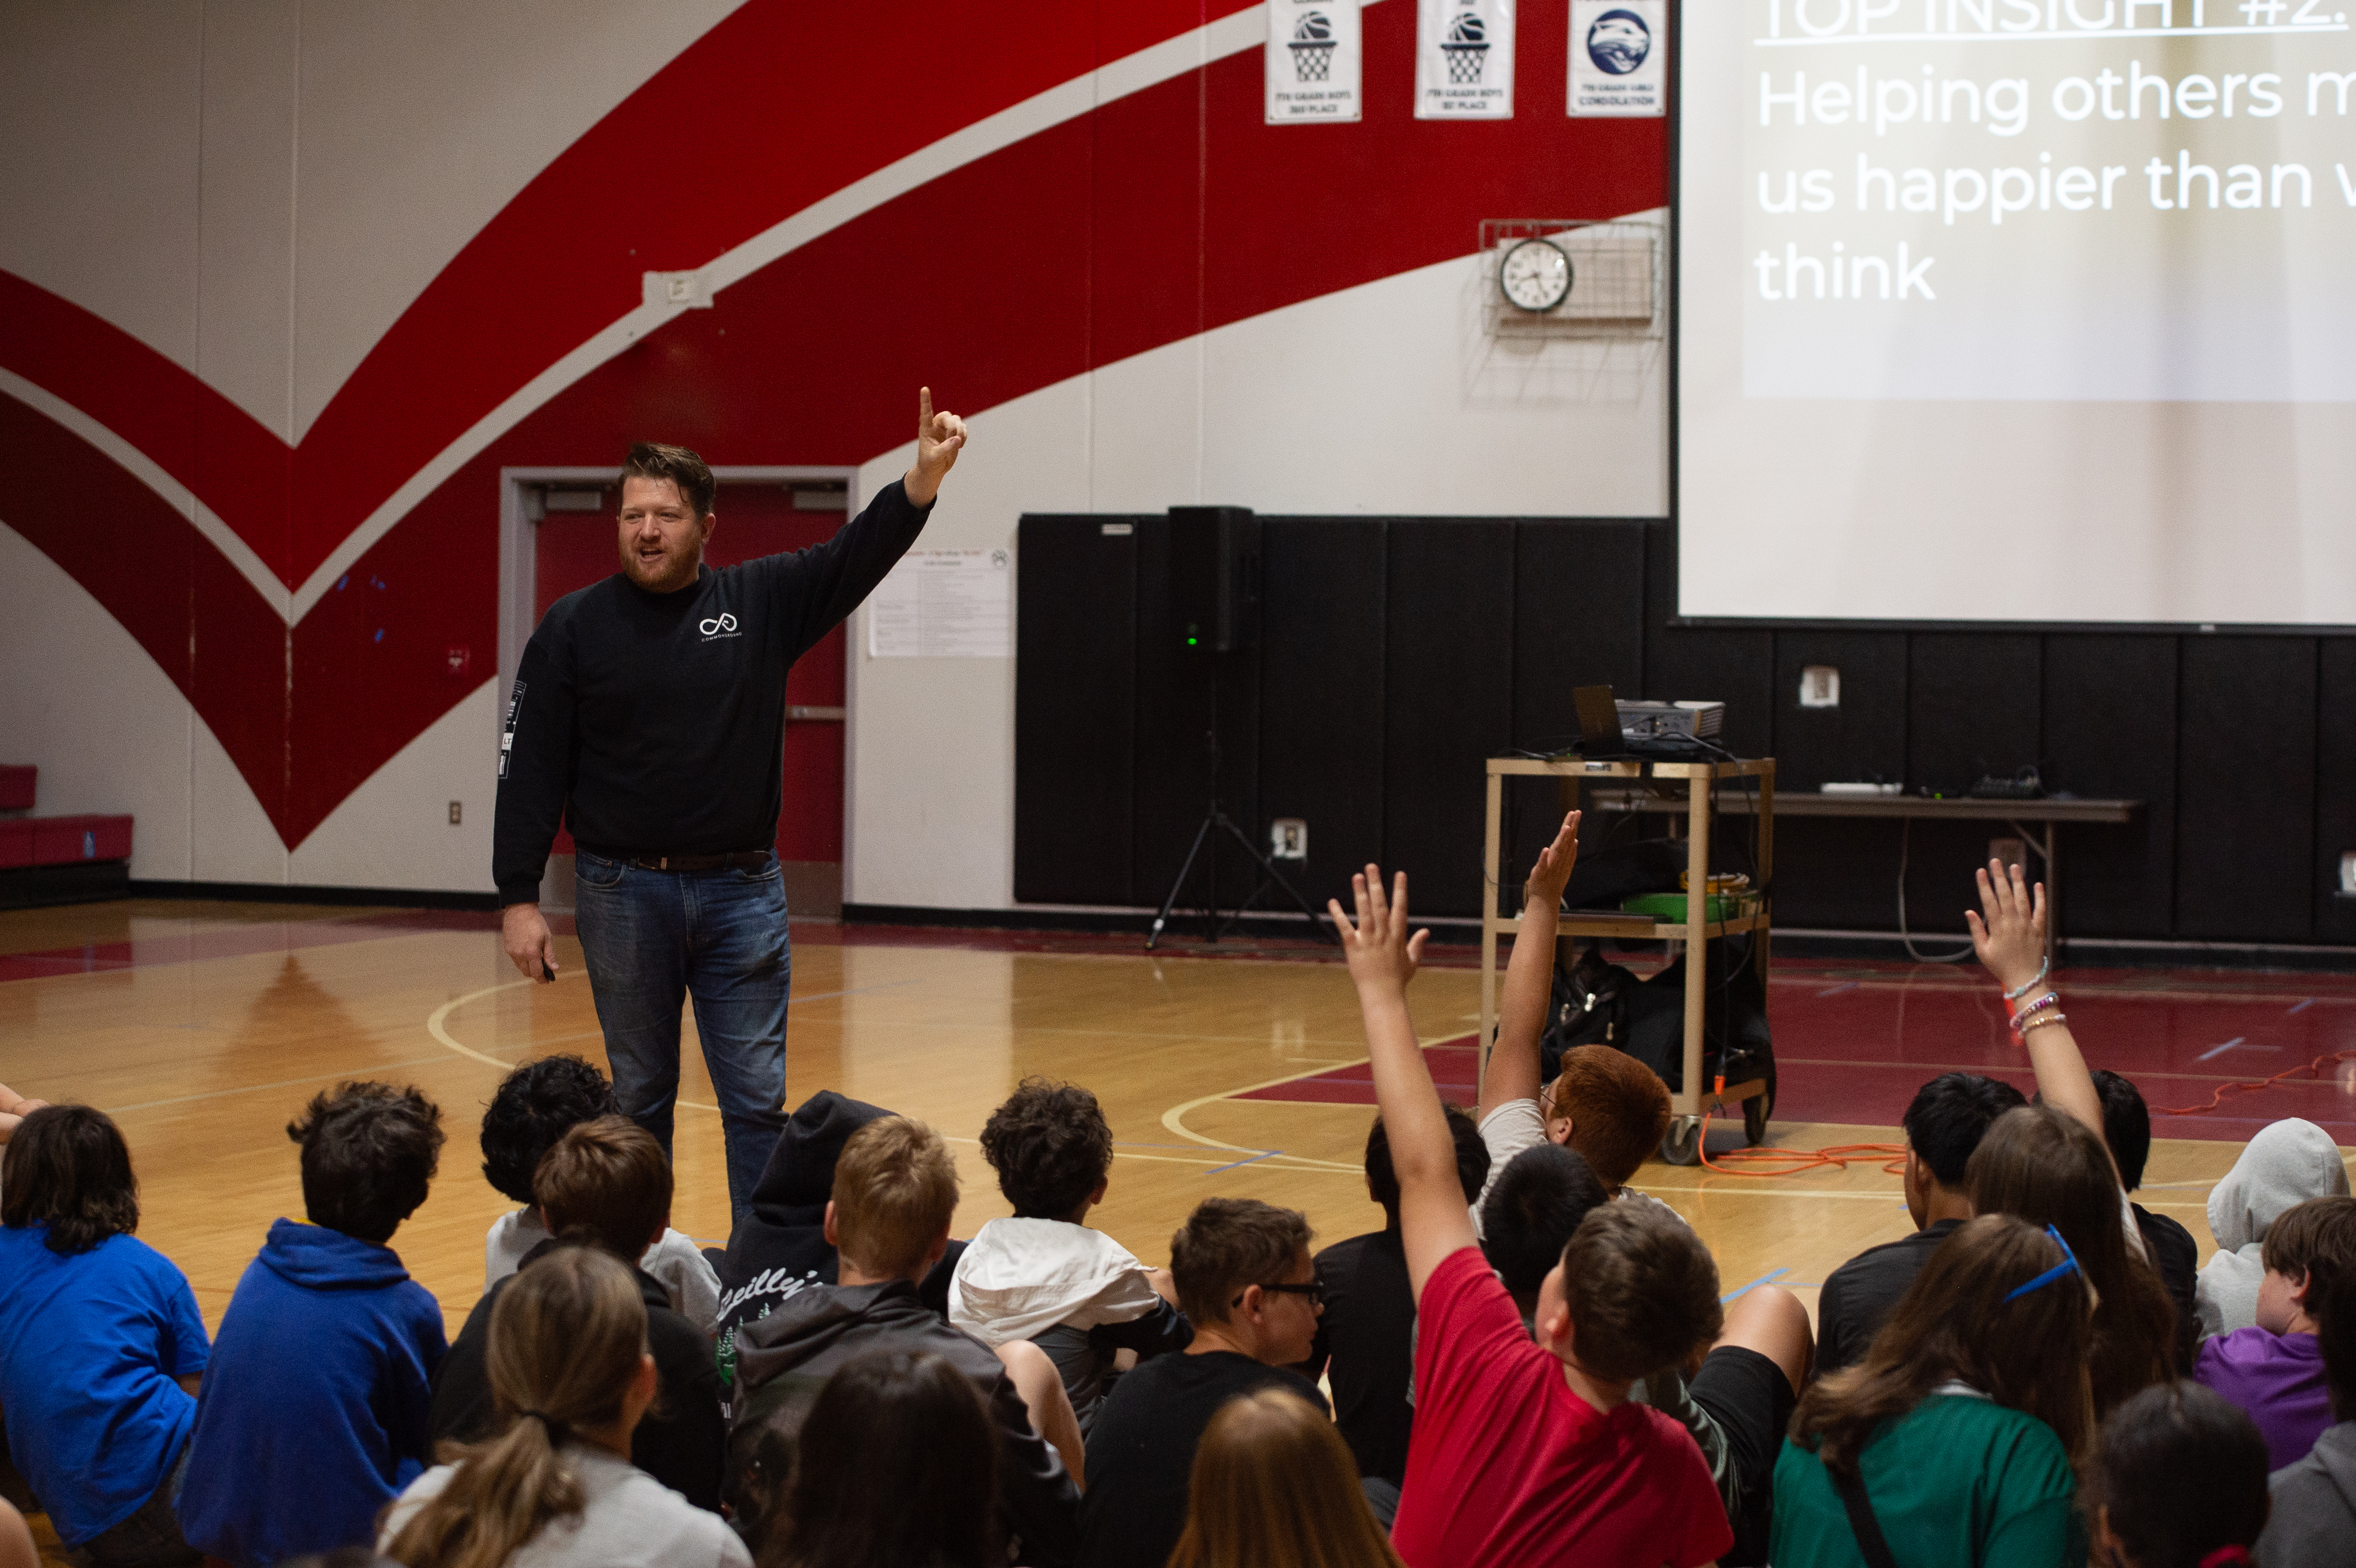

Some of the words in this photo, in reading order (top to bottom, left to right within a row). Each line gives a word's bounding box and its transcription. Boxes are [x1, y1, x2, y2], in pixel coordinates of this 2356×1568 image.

[1769, 0, 1900, 38] TOP
[1759, 63, 2029, 137] Helping
[2051, 59, 2283, 121] others
[1758, 169, 1836, 214] us
[1856, 151, 2127, 226] happier
[2143, 148, 2312, 211] than
[1753, 240, 1937, 300] think
[701, 632, 743, 642] COMMONGROUND
[716, 1267, 824, 1323] eilly'
